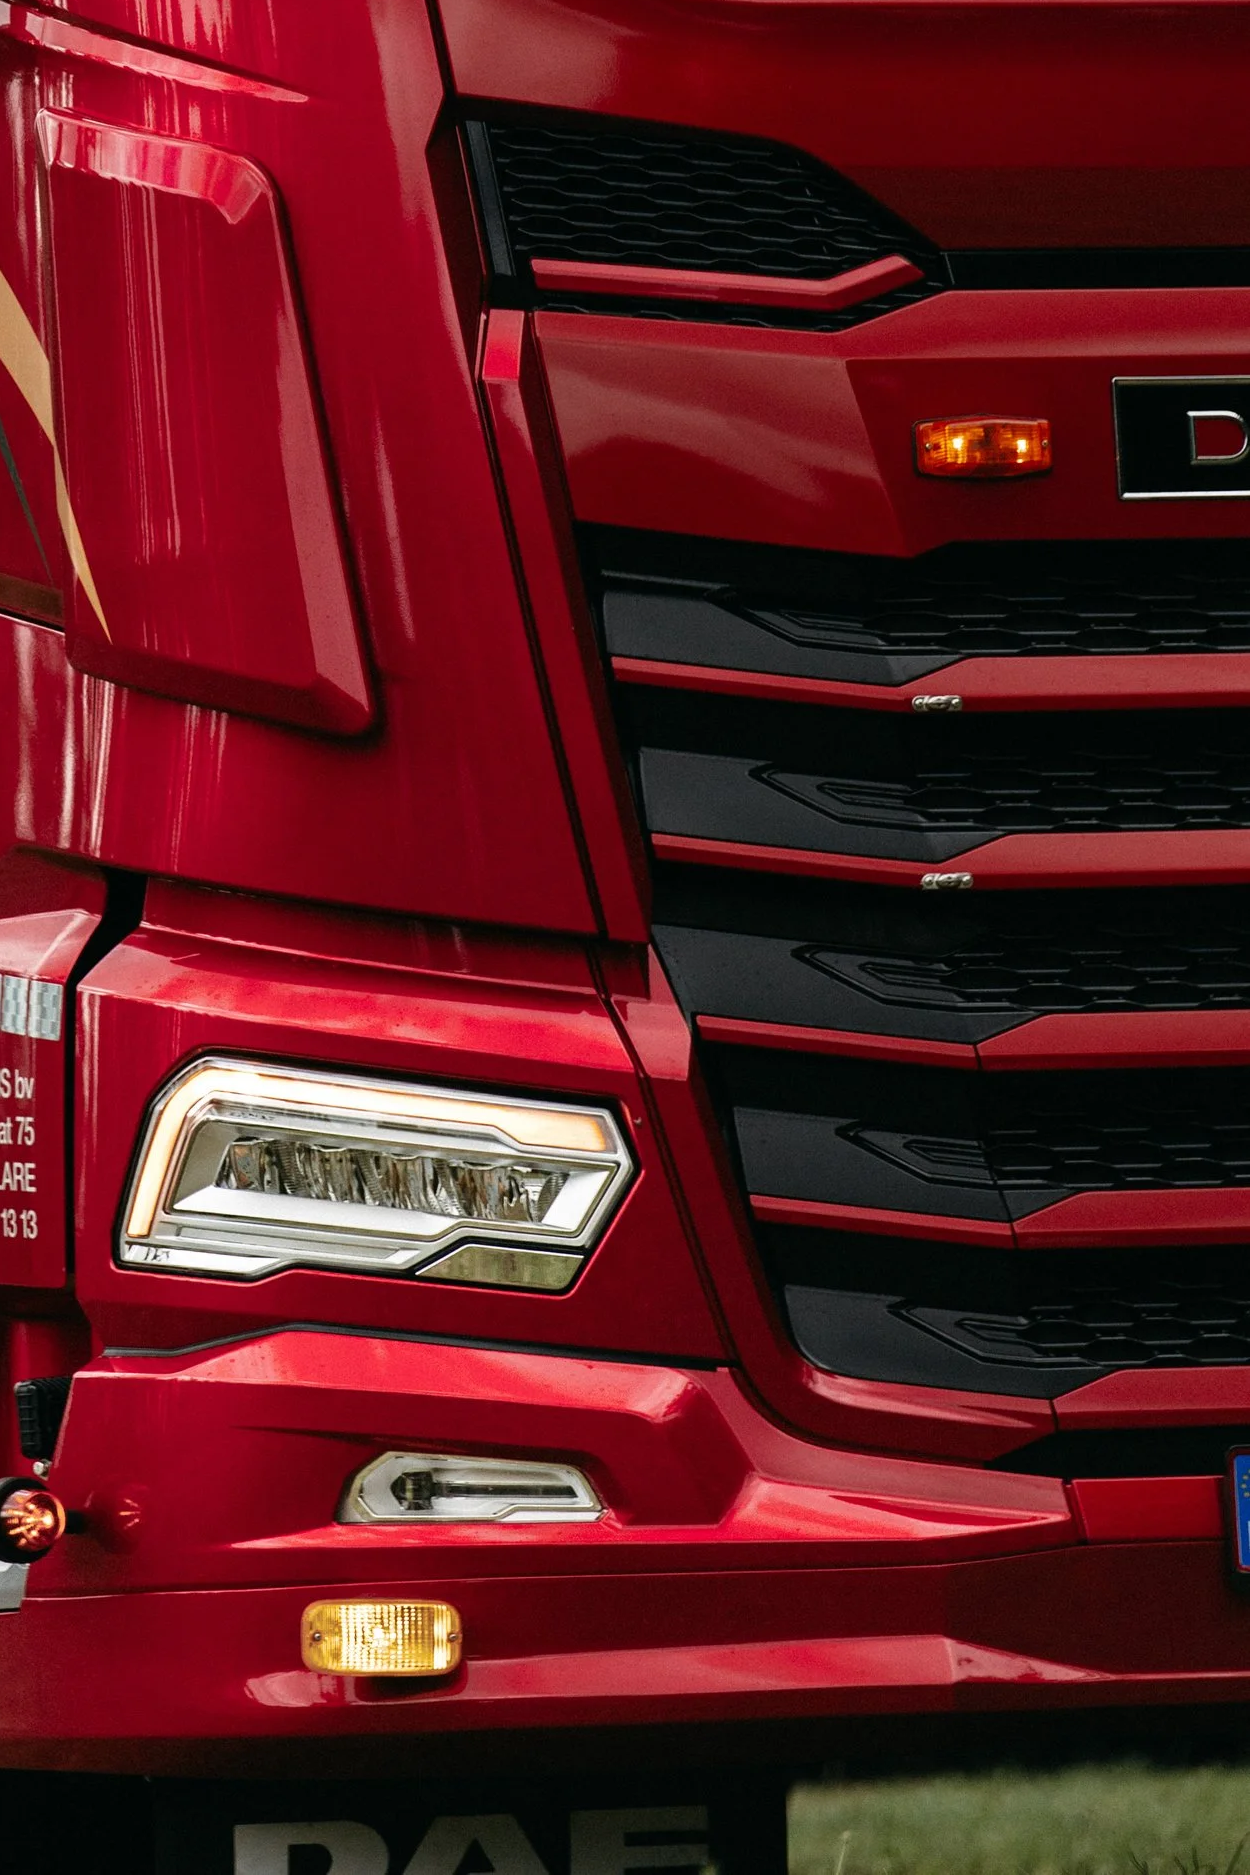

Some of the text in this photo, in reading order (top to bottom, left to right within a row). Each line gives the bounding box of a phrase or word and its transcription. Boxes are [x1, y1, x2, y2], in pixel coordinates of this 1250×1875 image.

[15, 1069, 34, 1099] bv
[15, 1116, 36, 1146] 75
[0, 1208, 18, 1238] 13
[19, 1209, 39, 1240] 13
